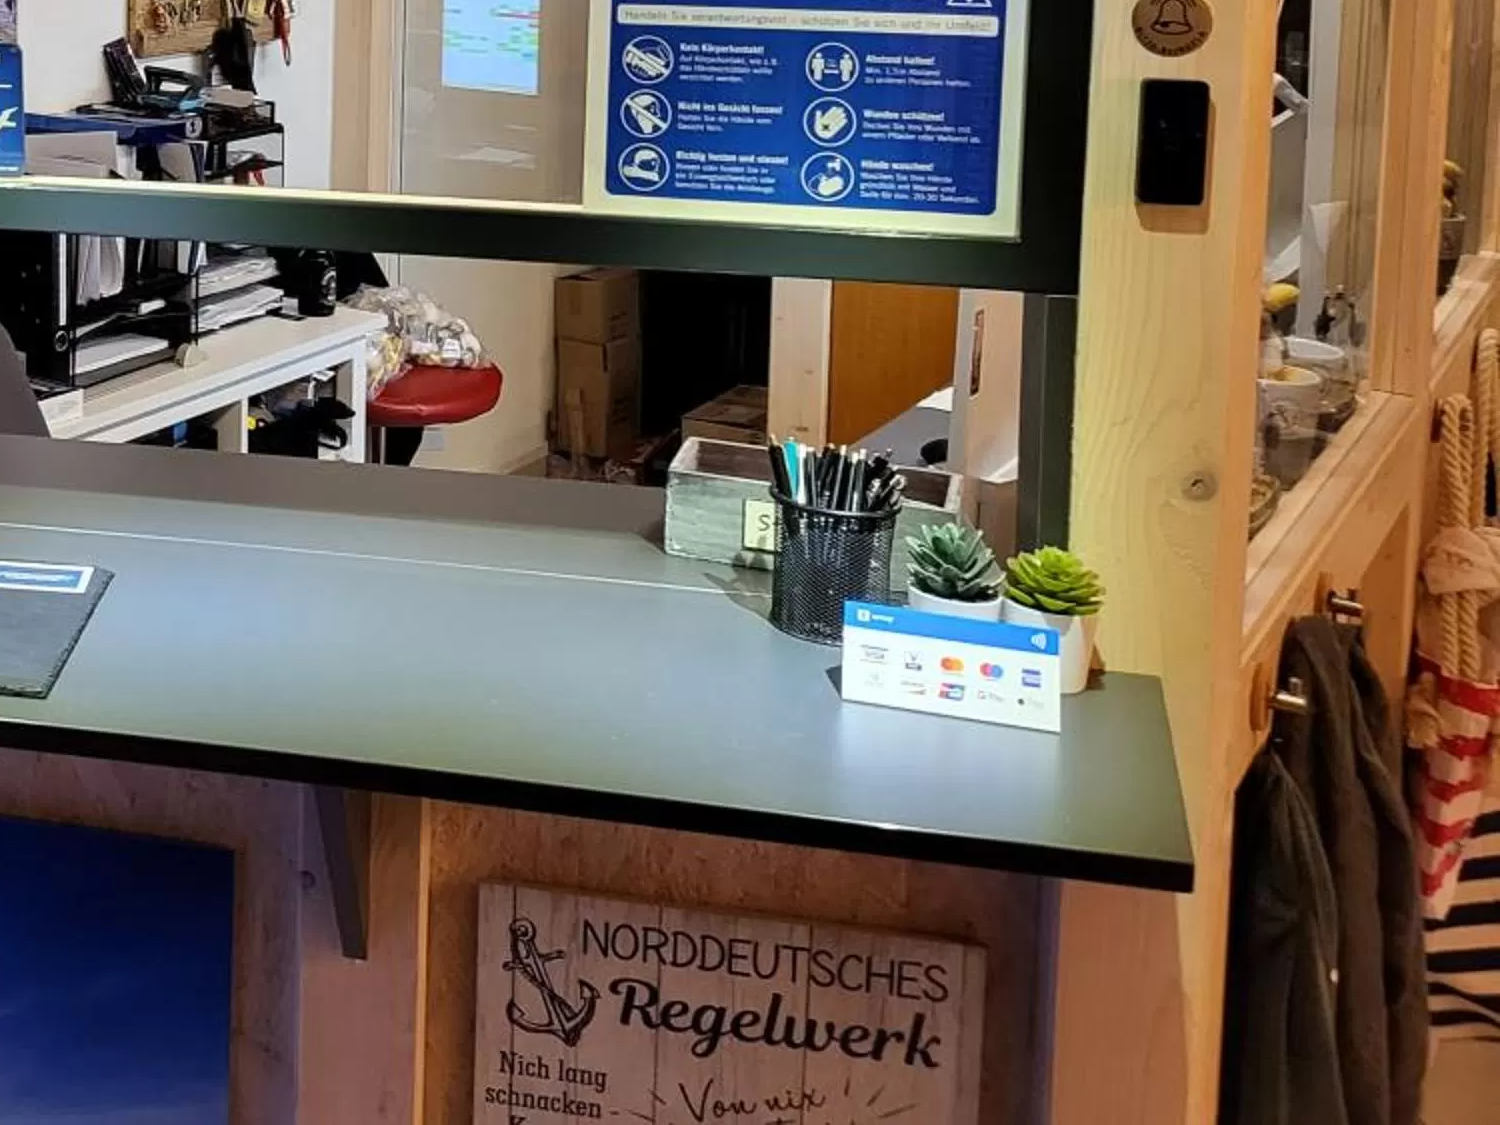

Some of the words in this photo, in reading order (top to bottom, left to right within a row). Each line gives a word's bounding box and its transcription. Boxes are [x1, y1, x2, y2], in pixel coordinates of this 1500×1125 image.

[582, 918, 949, 1004] NORDDEUTSCHES
[609, 977, 942, 1070] Regelwerk
[499, 1051, 550, 1082] Nich
[557, 1062, 608, 1093] lang
[485, 1084, 602, 1120] schnacken
[678, 1079, 757, 1123] Von
[763, 1085, 826, 1112] nix
